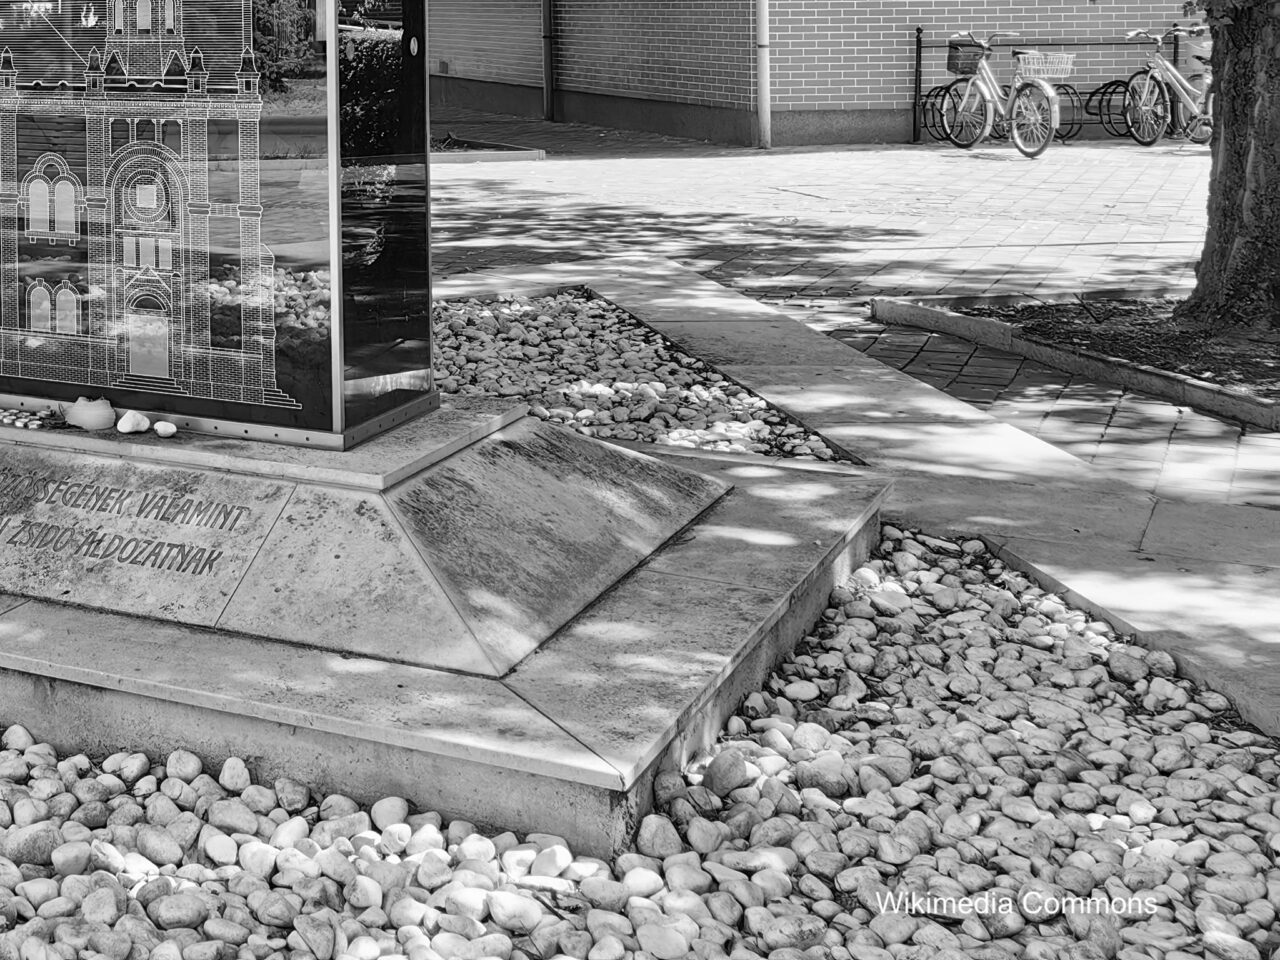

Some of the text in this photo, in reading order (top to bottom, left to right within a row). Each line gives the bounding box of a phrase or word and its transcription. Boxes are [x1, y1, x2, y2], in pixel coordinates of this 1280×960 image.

[134, 492, 250, 531] VALAMINT
[5, 518, 79, 553] ZSIDÓ
[73, 525, 224, 576] ÁLDOZATNAK
